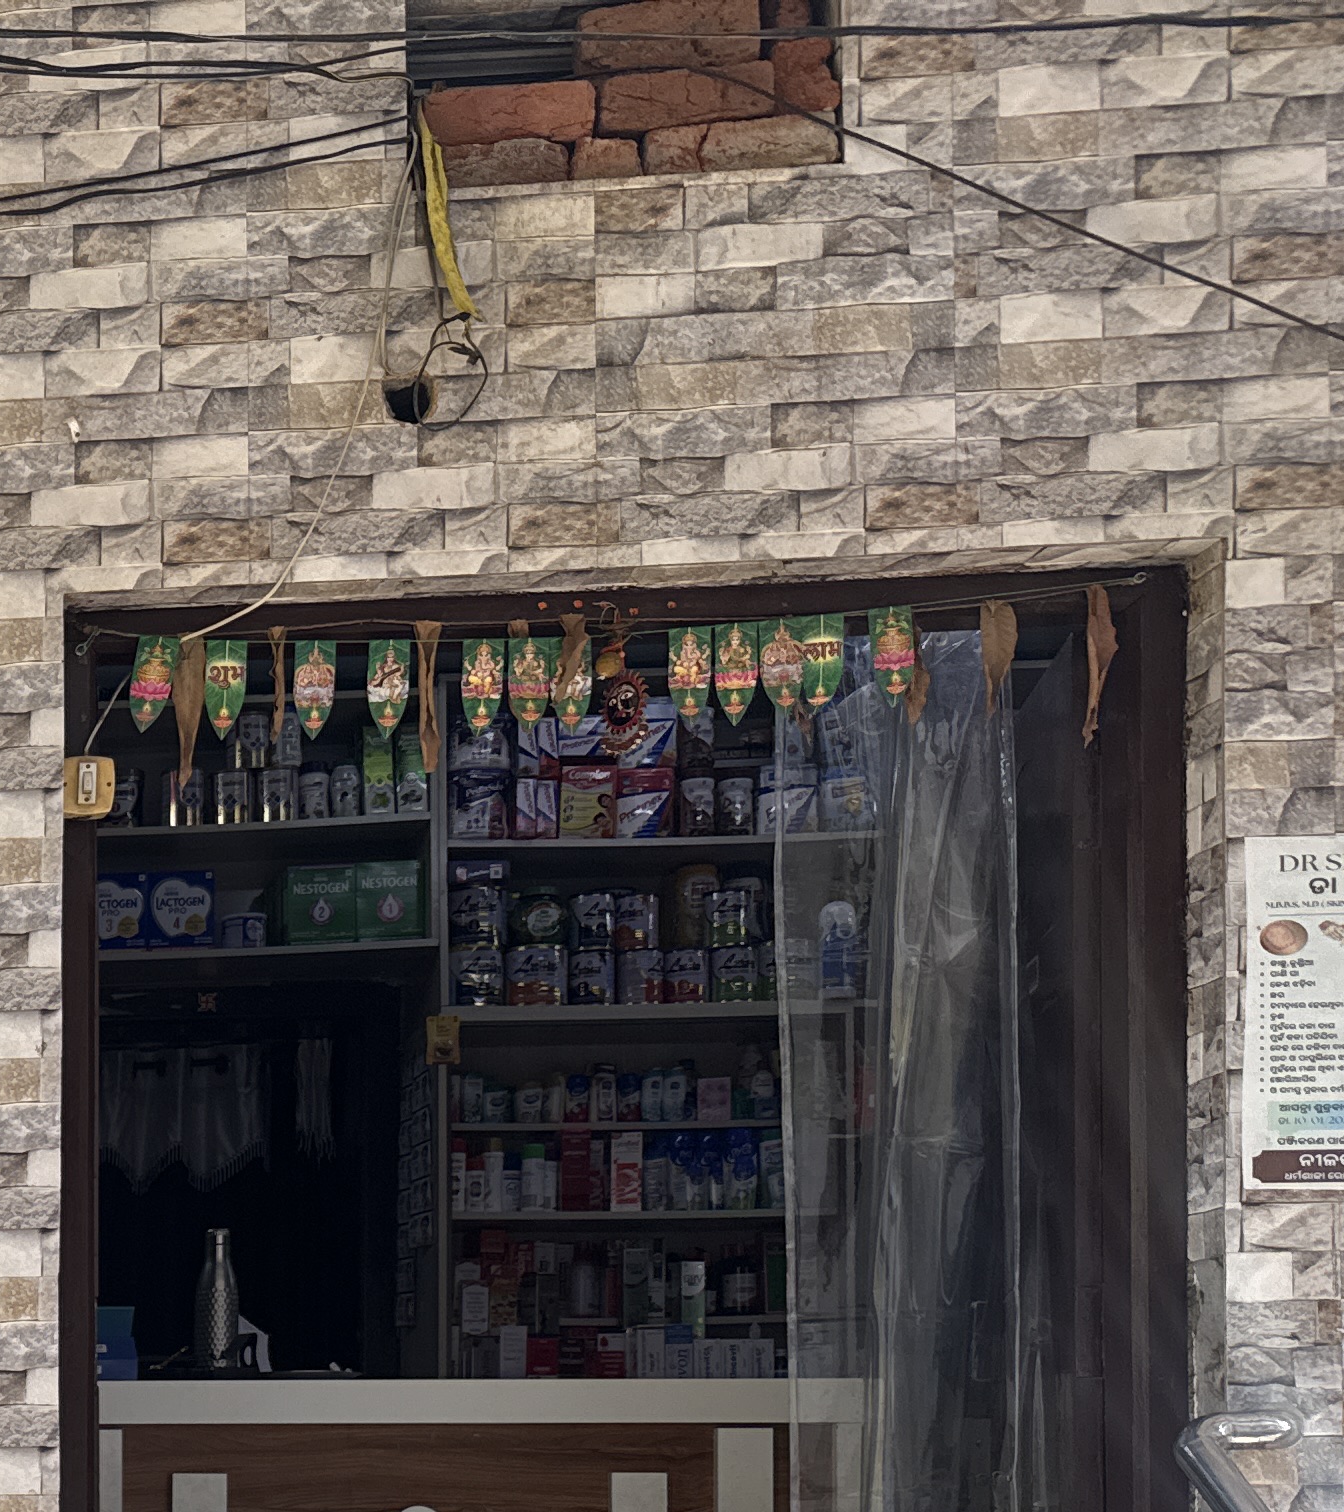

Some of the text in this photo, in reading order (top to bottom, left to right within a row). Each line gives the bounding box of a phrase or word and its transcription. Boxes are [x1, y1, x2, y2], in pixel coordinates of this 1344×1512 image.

[208, 666, 245, 690] शुभ
[1279, 854, 1318, 872] DR
[293, 880, 349, 895] NESTOGEN
[362, 875, 417, 889] NESTOGEN
[156, 894, 205, 910] LACTOGEN
[318, 906, 325, 918] 2
[173, 917, 180, 929] 4
